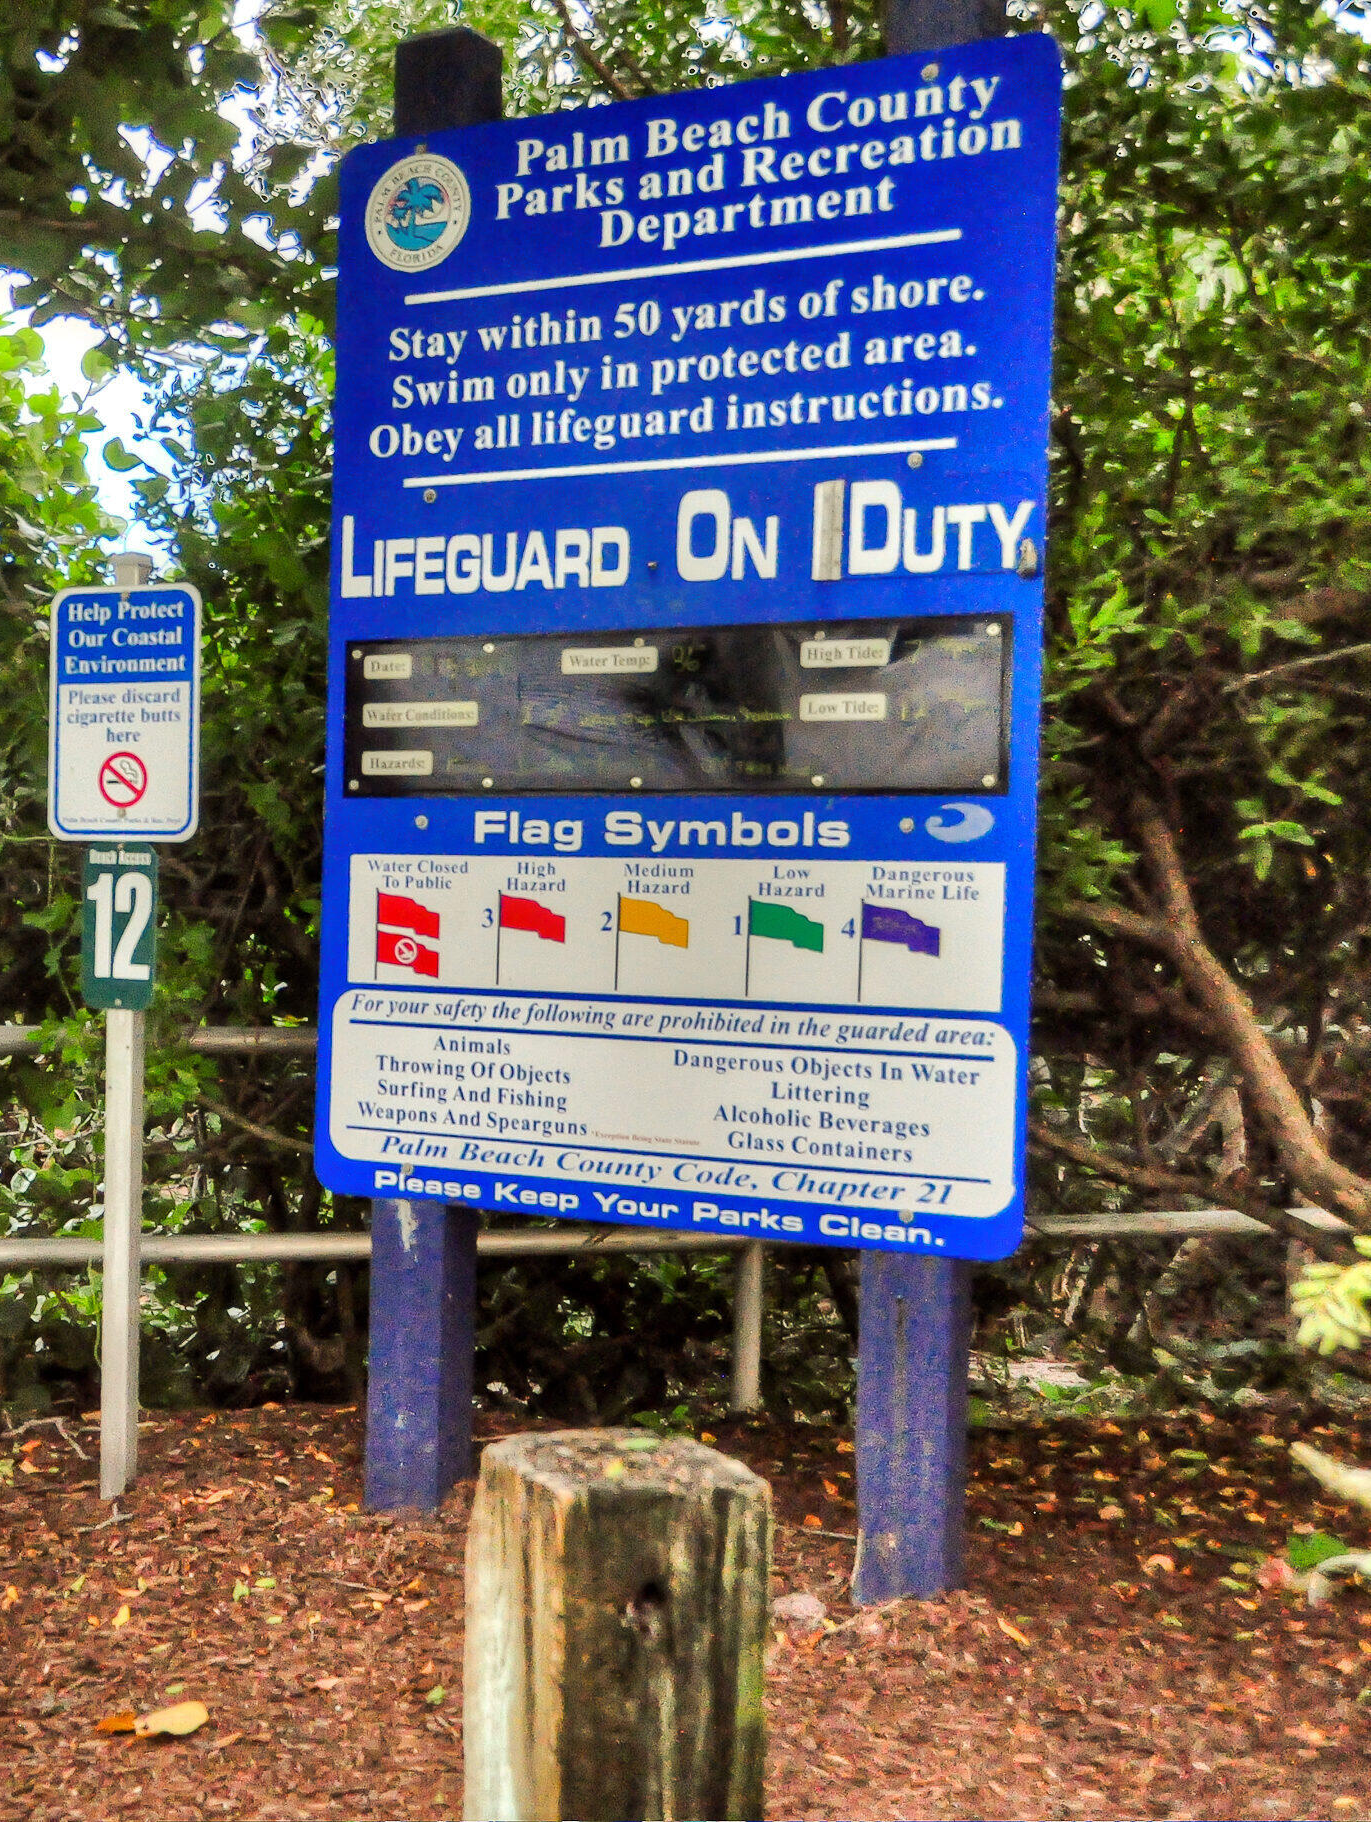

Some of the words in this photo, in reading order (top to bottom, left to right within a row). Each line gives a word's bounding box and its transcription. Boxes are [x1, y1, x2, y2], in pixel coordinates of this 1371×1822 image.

[517, 133, 629, 176] Palm
[646, 99, 791, 160] Beach
[807, 75, 1001, 139] County
[496, 176, 624, 220] Parks
[639, 152, 726, 201] and
[741, 115, 1023, 187] Recreation
[598, 176, 895, 249] Department
[390, 244, 443, 262] FLORIDA
[389, 328, 466, 364] Stay
[478, 311, 602, 352] within
[615, 301, 661, 338] 50
[671, 290, 785, 341] yards
[798, 280, 845, 320] of
[851, 275, 985, 316] shore.
[392, 367, 495, 409] Swim
[507, 360, 589, 404] only
[601, 355, 640, 388] in
[652, 334, 851, 395] protected
[863, 335, 977, 366] area.
[370, 424, 463, 462] Obey
[474, 417, 520, 452] all
[532, 399, 715, 452] lifeguard
[726, 381, 1004, 431] instructions.
[68, 602, 111, 626] Help
[118, 601, 184, 619] Protect
[69, 629, 107, 648] Our
[112, 626, 183, 646] Coastal
[570, 655, 609, 667] Water
[614, 654, 650, 669] Temp:
[807, 647, 842, 662] High
[846, 645, 883, 660] Tide:
[64, 655, 186, 674] Environment
[371, 661, 405, 673] Date:
[69, 690, 116, 704] Please
[122, 688, 180, 703] discard
[405, 708, 474, 721] Conditions:
[808, 701, 836, 714] Low
[841, 700, 879, 714] Tide:
[67, 709, 135, 726] cigarette
[141, 708, 180, 722] butts
[106, 727, 140, 742] here
[370, 758, 425, 770] Hazards:
[474, 810, 583, 852] Flag
[605, 811, 850, 854] Symbols
[368, 860, 412, 873] Water
[417, 861, 468, 874] Closed
[517, 862, 556, 878] High
[624, 864, 694, 879] Medium
[773, 866, 810, 879] Low
[872, 867, 975, 884] Dangerous
[383, 877, 399, 888] To
[405, 877, 452, 889] Public
[508, 878, 566, 892] Hazard
[627, 879, 690, 895] Hazard
[759, 882, 825, 897] Hazard
[866, 884, 935, 899] Marine
[942, 886, 979, 900] Life
[87, 872, 150, 981] 12
[482, 909, 493, 927] 3
[601, 912, 612, 931] 2
[733, 915, 741, 935] 1
[841, 918, 855, 938] 4
[351, 993, 380, 1011] For
[386, 1000, 429, 1016] your
[434, 1000, 486, 1022] safety
[492, 1003, 521, 1020] the
[523, 1005, 616, 1029] following
[622, 1012, 653, 1027] are
[658, 1014, 764, 1034] prohibited
[770, 1016, 790, 1035] in
[798, 1021, 830, 1037] the
[836, 1023, 929, 1044] guarded
[936, 1027, 995, 1046] area:
[433, 1035, 511, 1055] Animals
[377, 1055, 464, 1079] Throwing
[471, 1061, 495, 1078] Of
[499, 1063, 571, 1085] Objects
[674, 1049, 783, 1074] Dangerous
[791, 1056, 872, 1081] Objects
[880, 1062, 902, 1080] In
[912, 1063, 979, 1085] Water
[377, 1080, 447, 1101] Surfing
[454, 1087, 490, 1104] And
[497, 1089, 567, 1112] Fishing
[771, 1082, 870, 1110] Littering
[358, 1101, 437, 1124] Weapons
[443, 1109, 480, 1127] And
[487, 1112, 587, 1136] Spearguns
[714, 1105, 811, 1128] Alcoholic
[819, 1111, 930, 1139] Beverages
[728, 1131, 784, 1153] Glass
[791, 1136, 912, 1163] Containers
[381, 1135, 447, 1158] Palm
[459, 1142, 544, 1168] Beach
[557, 1154, 662, 1183] County
[673, 1162, 758, 1190] Code,
[772, 1170, 905, 1202] Chapter
[916, 1183, 953, 1204] 21
[374, 1169, 480, 1199] Please
[494, 1182, 579, 1212] Keep
[593, 1192, 678, 1219] Your
[692, 1201, 804, 1232] Parks
[819, 1213, 945, 1247] Clean.
